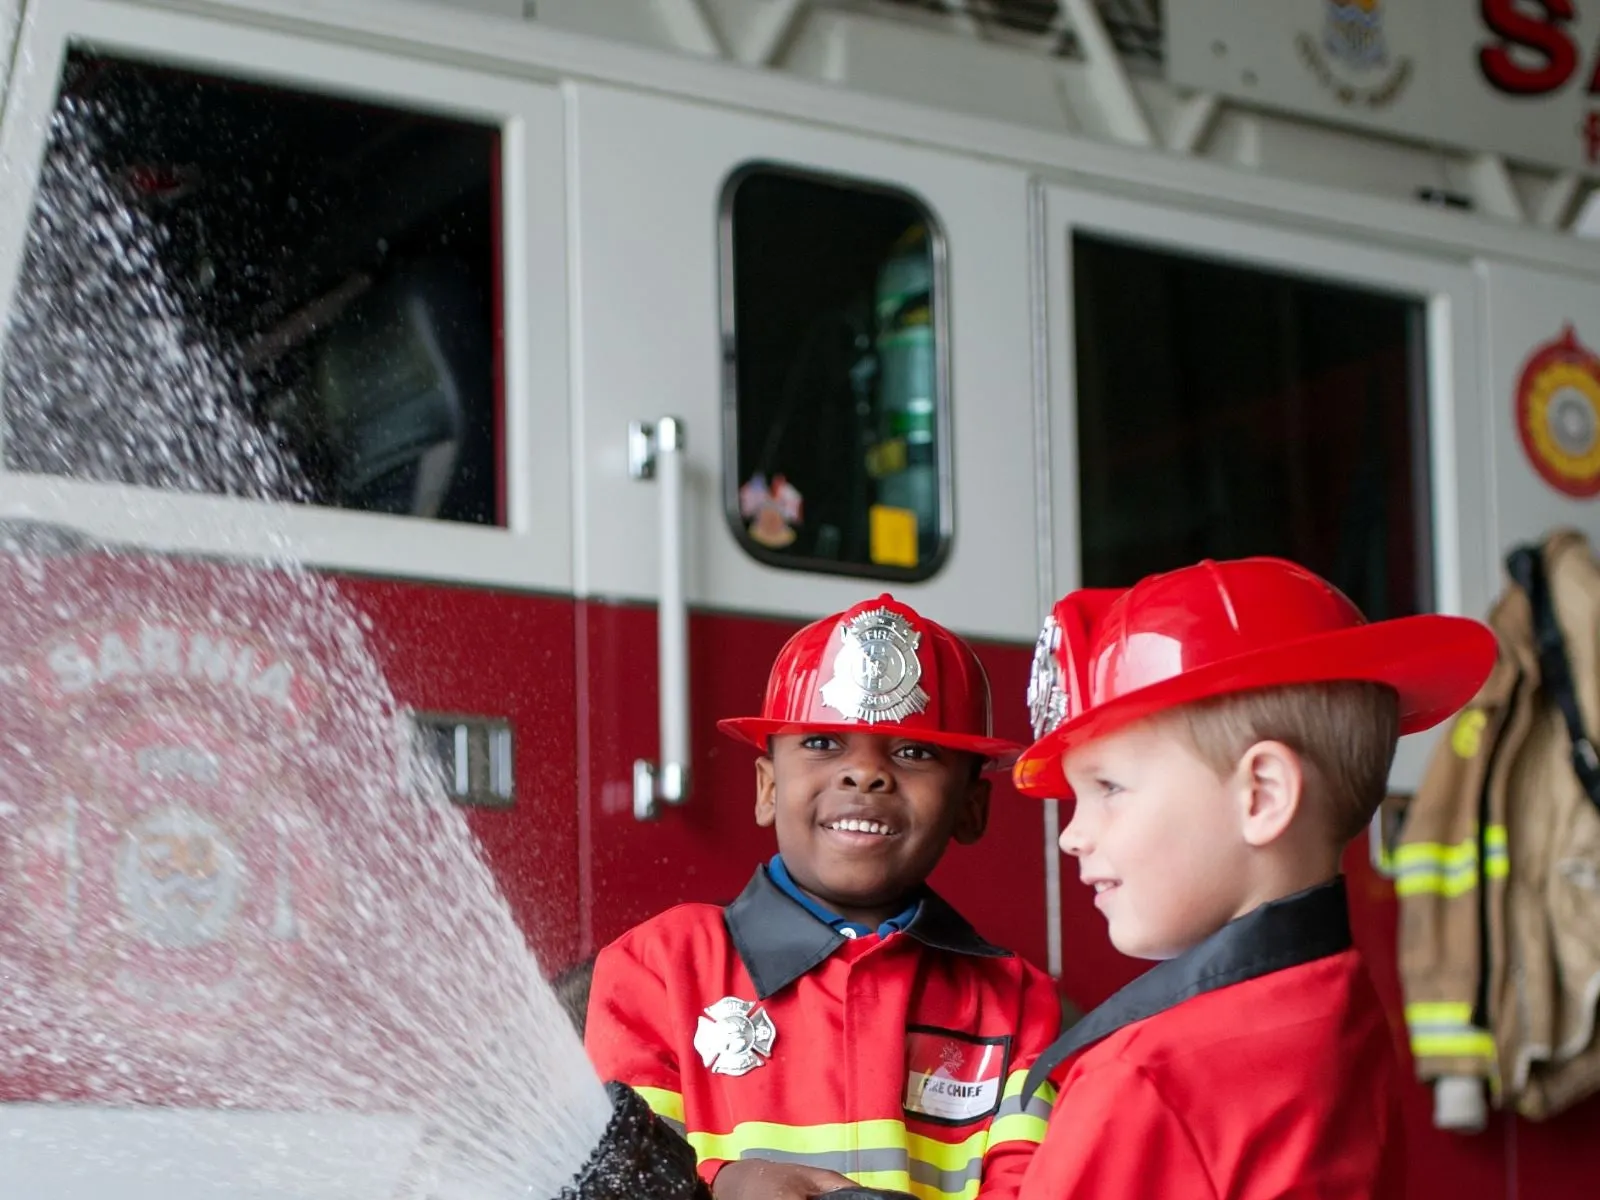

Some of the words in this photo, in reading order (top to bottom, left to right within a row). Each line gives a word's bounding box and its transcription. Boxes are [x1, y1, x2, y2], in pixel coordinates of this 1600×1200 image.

[864, 629, 895, 641] FIRE
[50, 624, 294, 704] SARNIA
[946, 1083, 983, 1098] CHIEF
